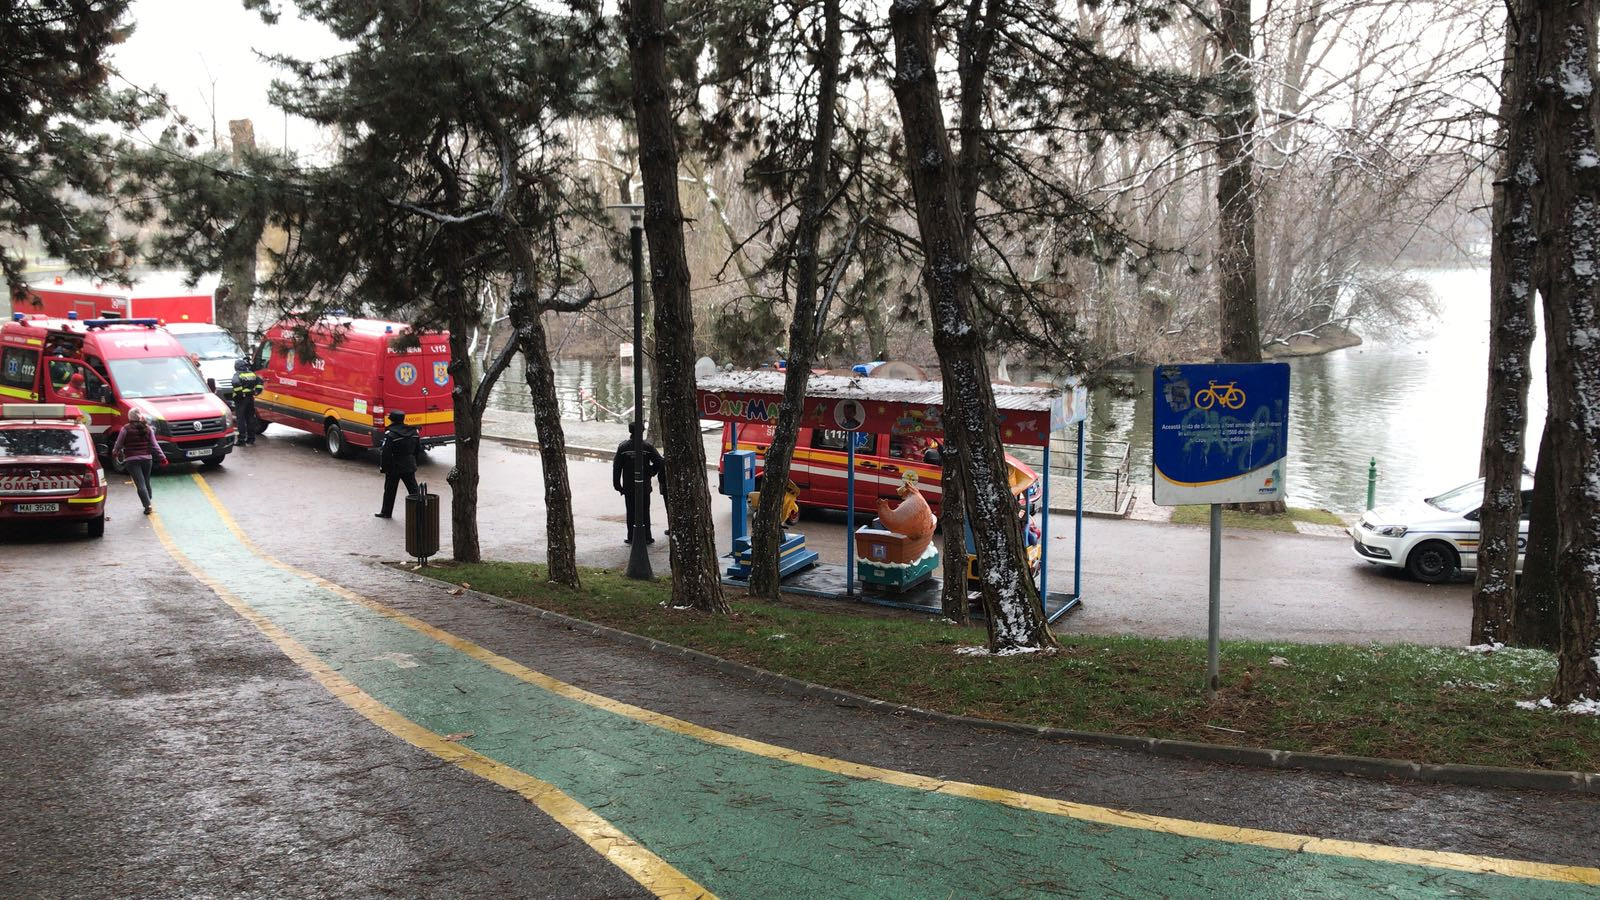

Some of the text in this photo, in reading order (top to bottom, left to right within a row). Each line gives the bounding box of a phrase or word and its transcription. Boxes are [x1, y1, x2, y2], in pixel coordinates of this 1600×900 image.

[434, 345, 447, 353] 112
[25, 365, 36, 376] 112
[0, 481, 70, 491] OMPIERII
